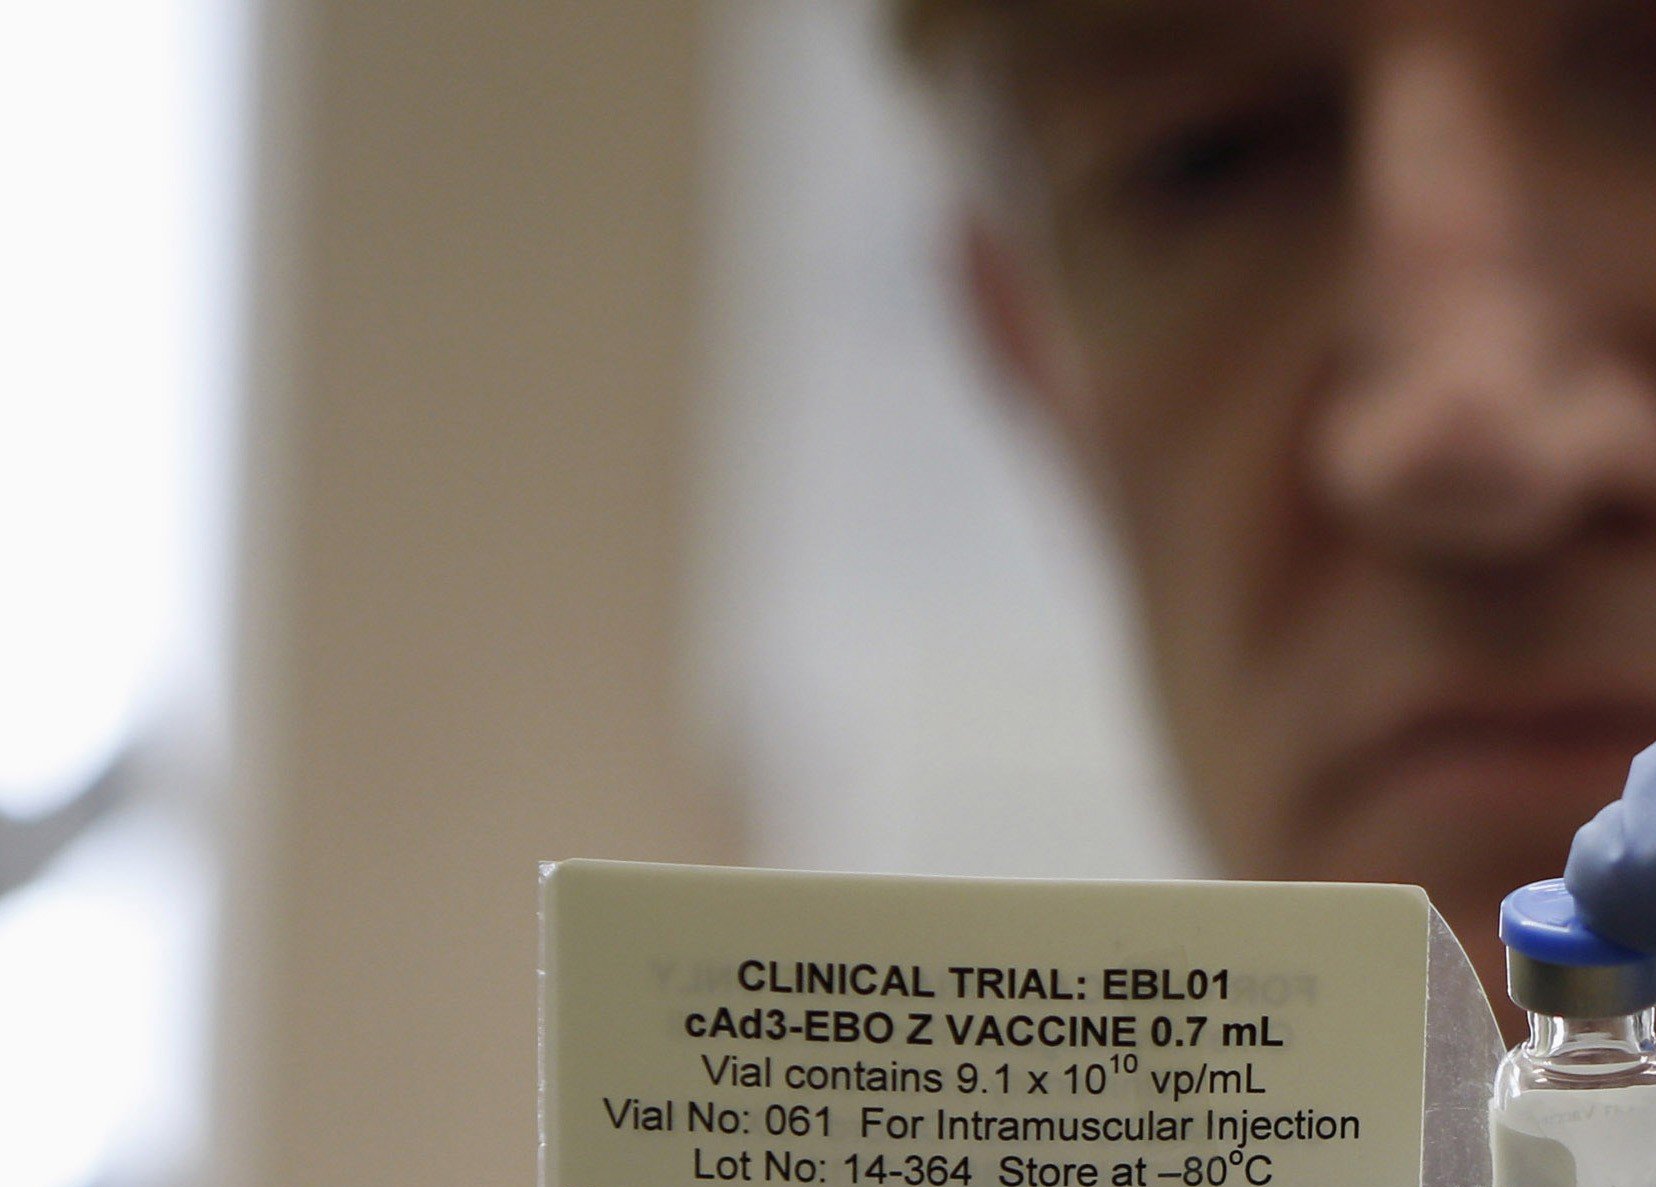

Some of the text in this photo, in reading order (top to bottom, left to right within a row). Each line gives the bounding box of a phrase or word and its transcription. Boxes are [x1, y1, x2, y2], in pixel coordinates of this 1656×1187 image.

[737, 959, 1229, 1001] CLINICAL TRIAL: EBL01
[683, 1006, 1284, 1048] cAd3-EBO Z VACCINE 0.7 mL
[700, 1053, 772, 1088] Vial
[784, 1060, 945, 1094] contains
[956, 1062, 1009, 1095] 9.1
[1026, 1070, 1049, 1095] x
[1150, 1062, 1267, 1103] vp/mL
[602, 1097, 1360, 1150] Vial No: 061 For Intramuscular Injection
[694, 1147, 753, 1182] Lot
[764, 1150, 826, 1184] No:
[844, 1152, 973, 1187] 14-364
[998, 1155, 1099, 1187] Store
[1110, 1156, 1148, 1187] at
